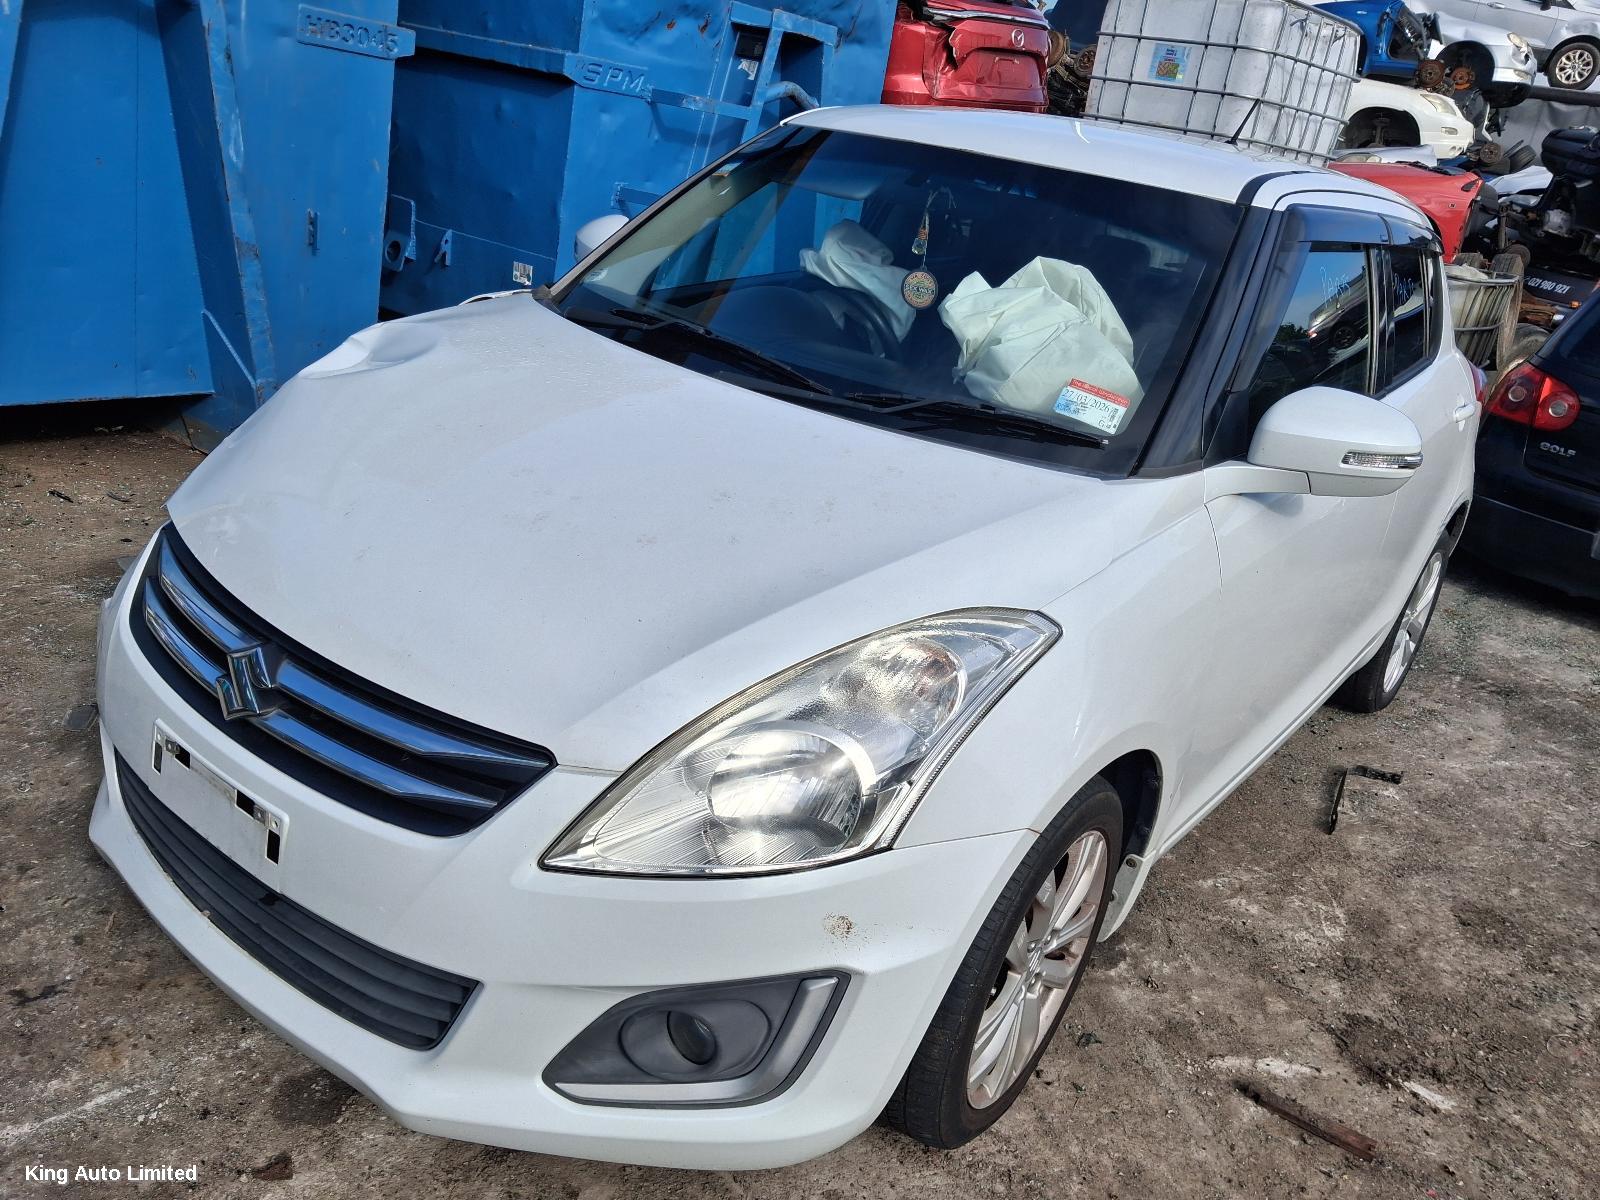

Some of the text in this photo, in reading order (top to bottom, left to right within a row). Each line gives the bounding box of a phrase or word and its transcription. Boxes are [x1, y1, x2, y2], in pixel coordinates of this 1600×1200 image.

[583, 62, 645, 92] SPM
[1062, 388, 1110, 414] 27/03/2026
[1540, 441, 1576, 457] GOLF
